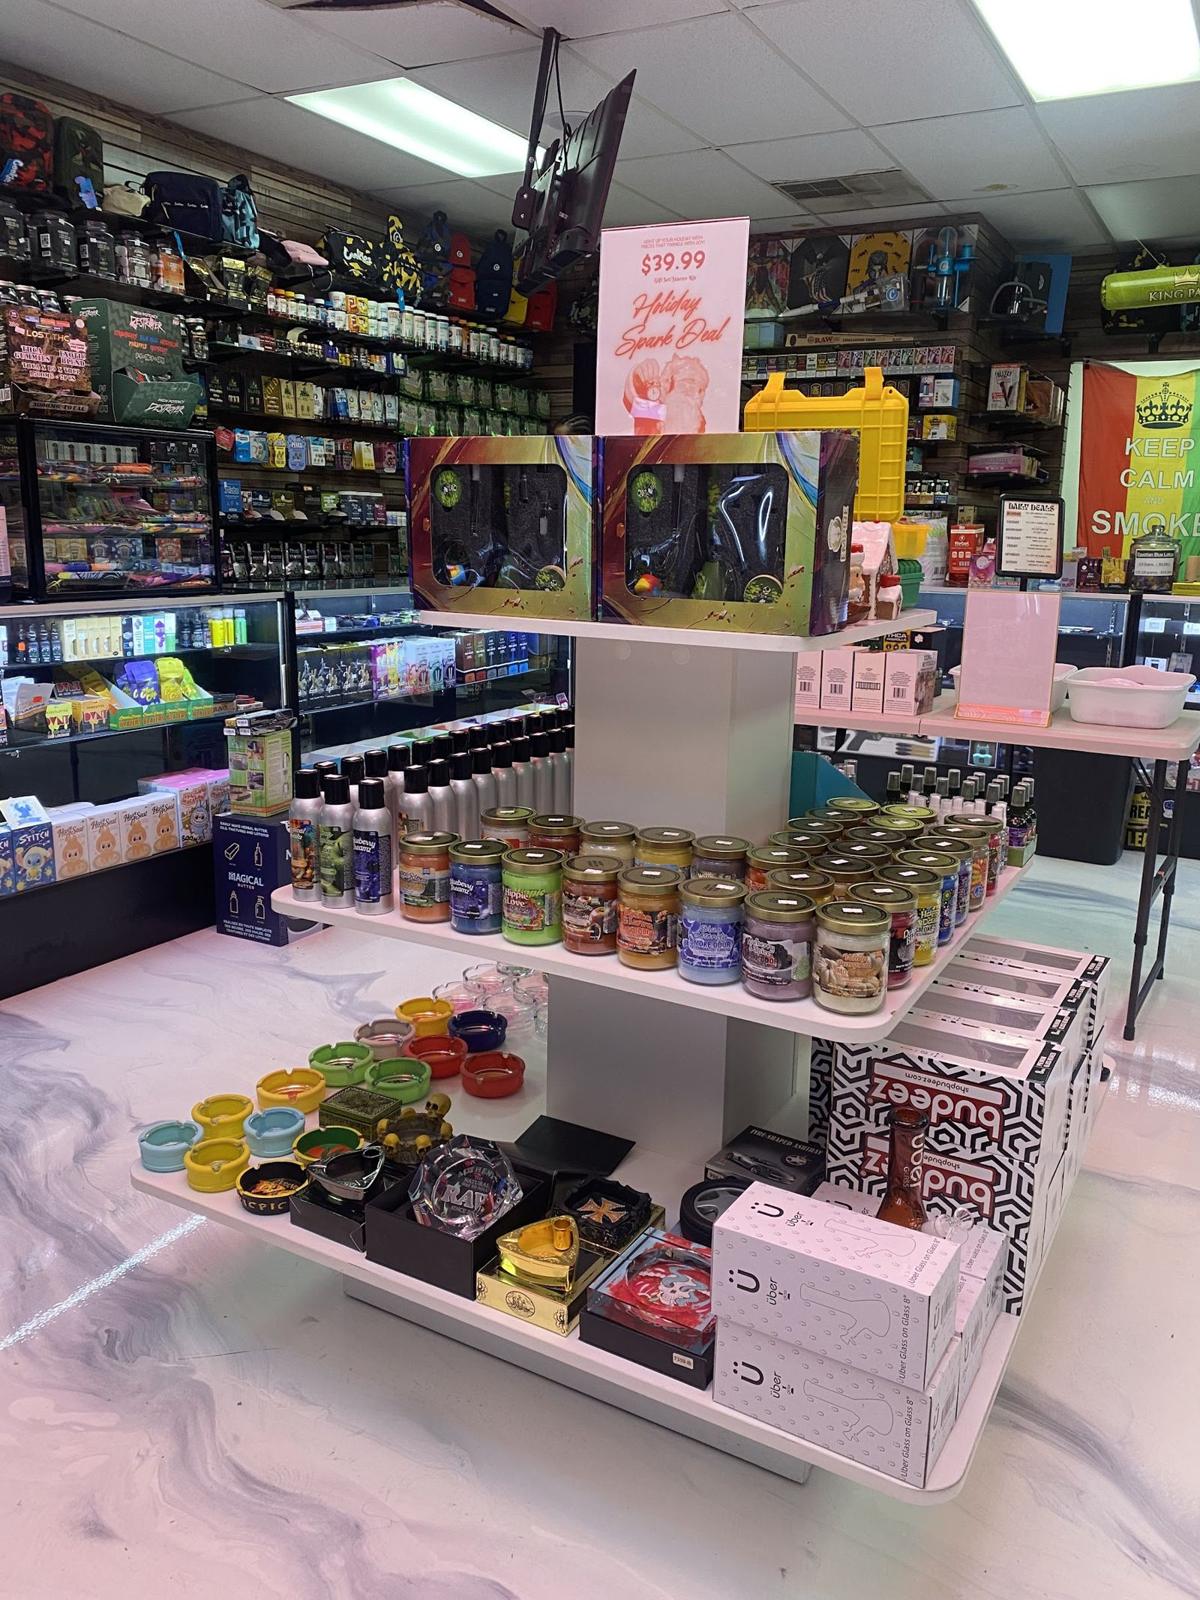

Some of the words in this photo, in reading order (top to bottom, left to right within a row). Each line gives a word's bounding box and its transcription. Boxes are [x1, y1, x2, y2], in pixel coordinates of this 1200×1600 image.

[641, 250, 705, 276] $39.99
[1149, 289, 1184, 301] KING
[632, 290, 702, 322] Holiday
[26, 330, 49, 339] LOST
[52, 333, 70, 342] THC
[615, 322, 675, 360] Spark
[675, 316, 732, 350] Deal
[1124, 437, 1195, 458] KEEP
[1119, 468, 1195, 490] CALM
[1008, 502, 1030, 511] DAILY
[1030, 504, 1056, 512] DEALS
[1130, 804, 1151, 819] REA
[19, 830, 50, 845] STITCH
[228, 871, 264, 887] MAGICAL
[505, 889, 529, 901] Hippie
[904, 1072, 970, 1094] shopbudeez.com
[868, 1076, 1002, 1141] budeez
[787, 1210, 803, 1228] über
[926, 1242, 938, 1256] Glass
[769, 1277, 778, 1306] über
[901, 1305, 910, 1327] Glass
[899, 1339, 908, 1360] Glass
[898, 1360, 906, 1380] Uber
[773, 1371, 783, 1399] über
[903, 1406, 912, 1427] Glass
[901, 1439, 910, 1459] Glass
